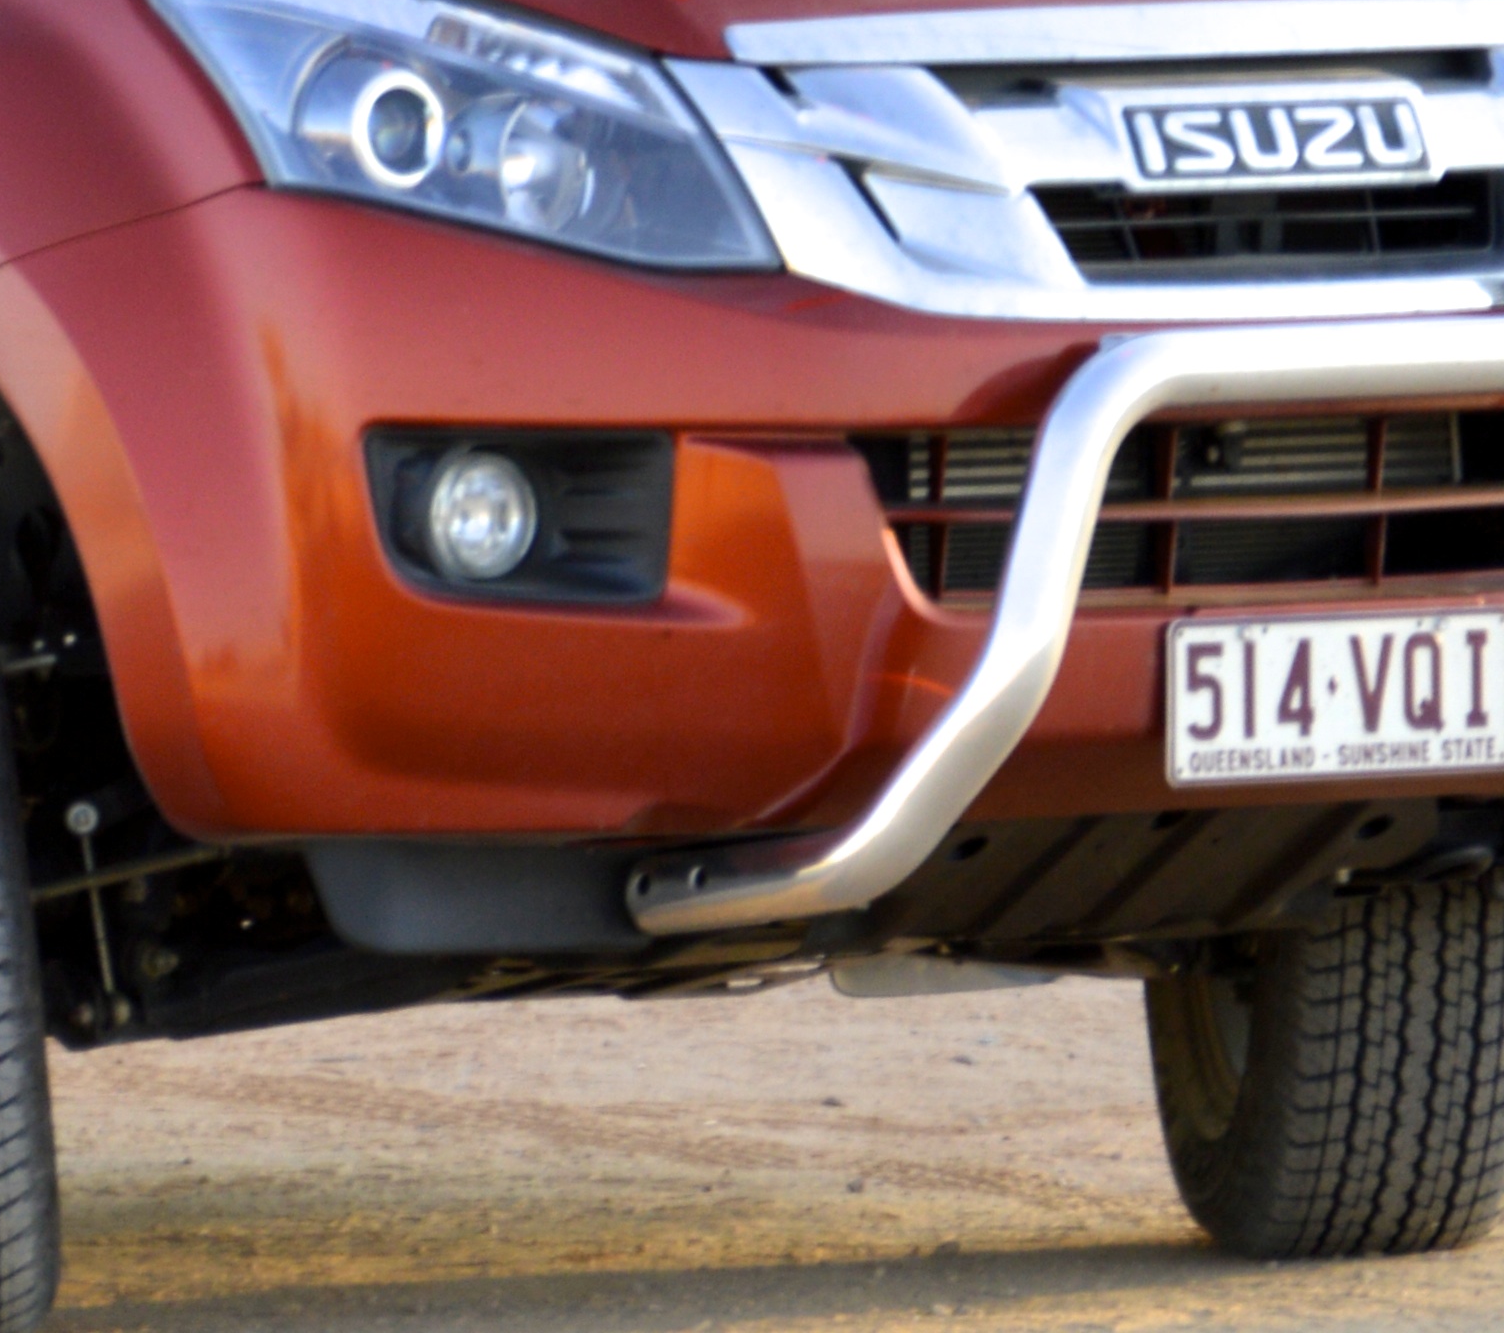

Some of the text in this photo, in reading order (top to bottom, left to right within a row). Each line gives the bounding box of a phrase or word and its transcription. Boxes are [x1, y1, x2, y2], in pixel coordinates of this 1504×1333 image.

[1131, 100, 1425, 176] ISUZU
[1188, 744, 1316, 773] QUEENSLAND
[1337, 738, 1430, 768] SUNSHINE
[1440, 735, 1497, 762] STATE
